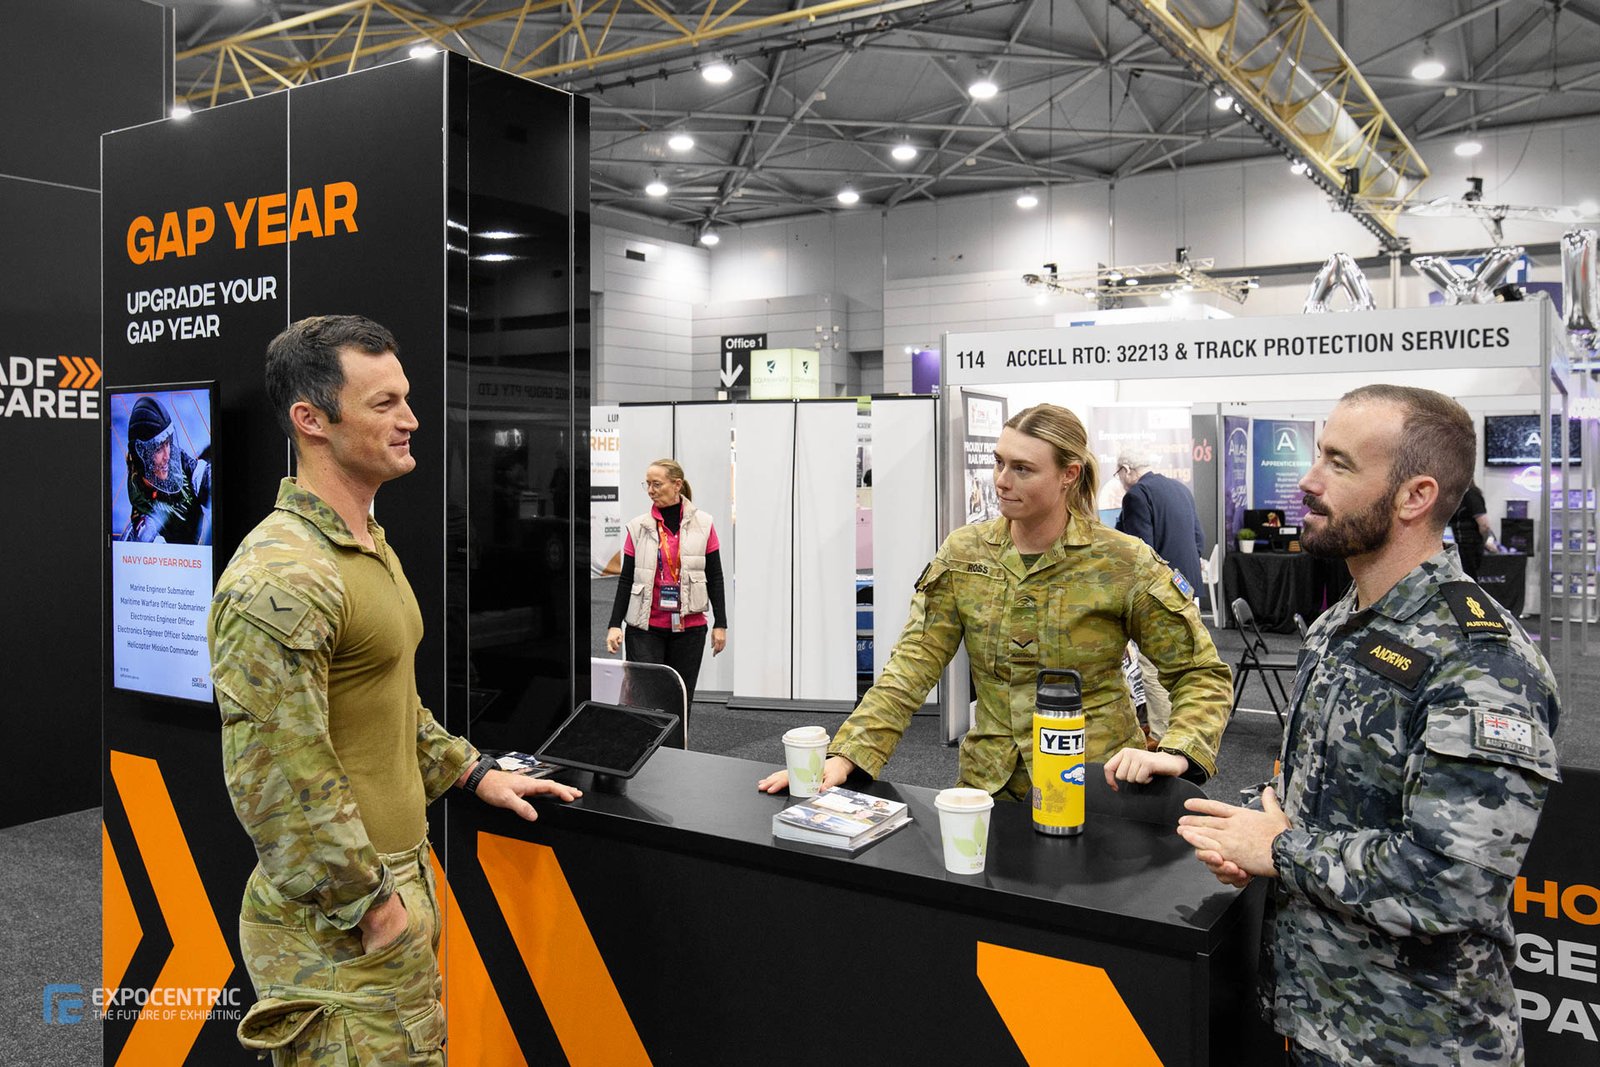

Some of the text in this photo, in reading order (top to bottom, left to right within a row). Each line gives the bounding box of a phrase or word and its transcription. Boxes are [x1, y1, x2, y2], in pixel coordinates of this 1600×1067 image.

[127, 181, 359, 265] GAP YEAR
[127, 275, 277, 315] UPGRADE YOUR
[127, 314, 220, 345] GAP YEAR
[725, 337, 763, 349] Office 1
[956, 326, 1510, 369] 114 ACCELL RTO: 32213 & TRACK PROTECTION SERVICES
[0, 387, 100, 420] AREE
[122, 555, 202, 568] NAVY GAP YEAR ROLES
[967, 563, 988, 574] ROSS
[130, 583, 195, 596] Marine Engineer Submariner
[120, 597, 206, 612] Maritime Warfare Officer Submariner
[130, 612, 195, 626] Electronics Engineer Officer
[1466, 621, 1503, 629] AUSTRALIA
[117, 625, 142, 635] Electronics
[143, 628, 163, 638] Engineer
[164, 630, 180, 640] Officer
[127, 640, 199, 657] Helicopter Mission Commander
